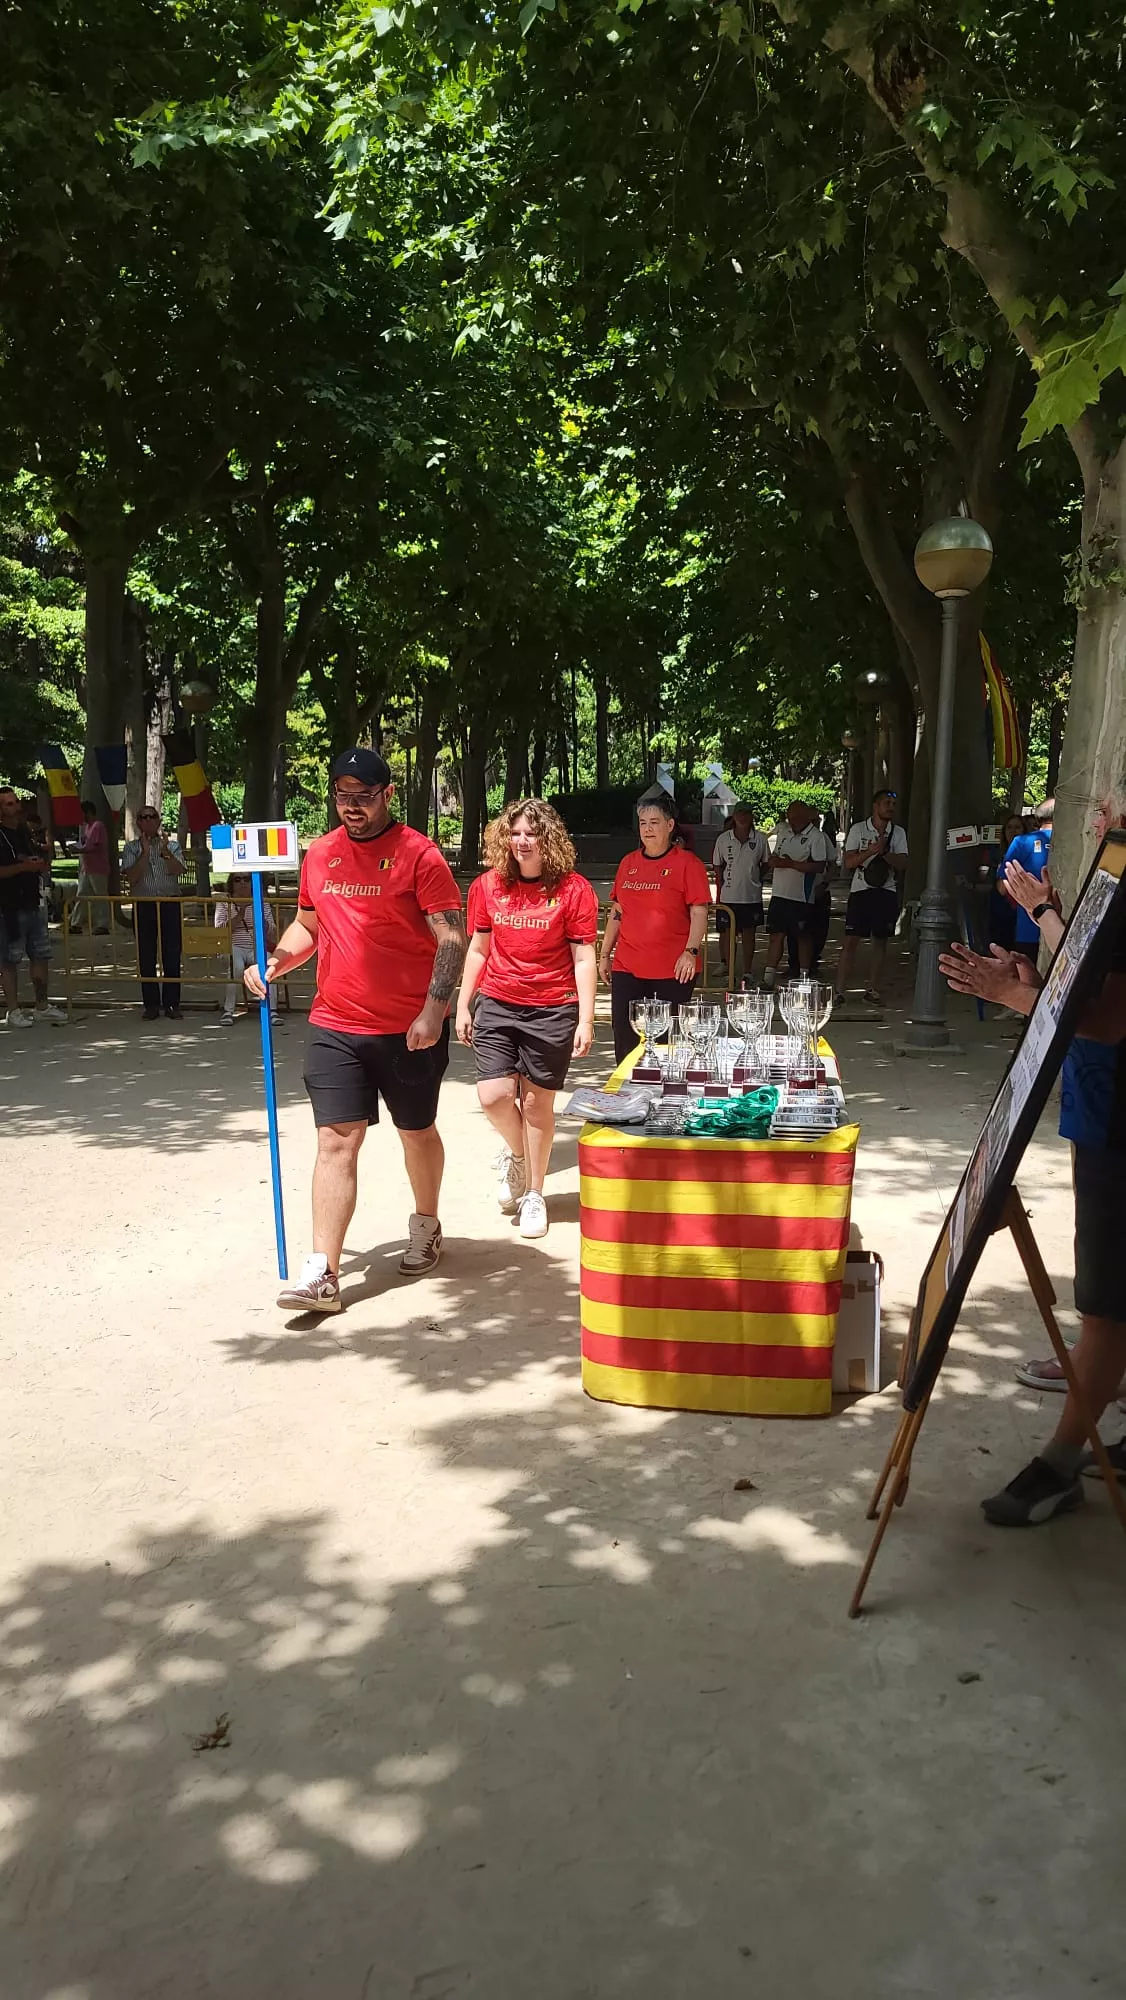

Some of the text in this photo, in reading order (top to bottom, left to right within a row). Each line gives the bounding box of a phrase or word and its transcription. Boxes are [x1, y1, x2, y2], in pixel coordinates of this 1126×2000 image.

[321, 880, 382, 898] Belgium
[622, 880, 661, 891] Belgium
[493, 911, 550, 930] Belgium
